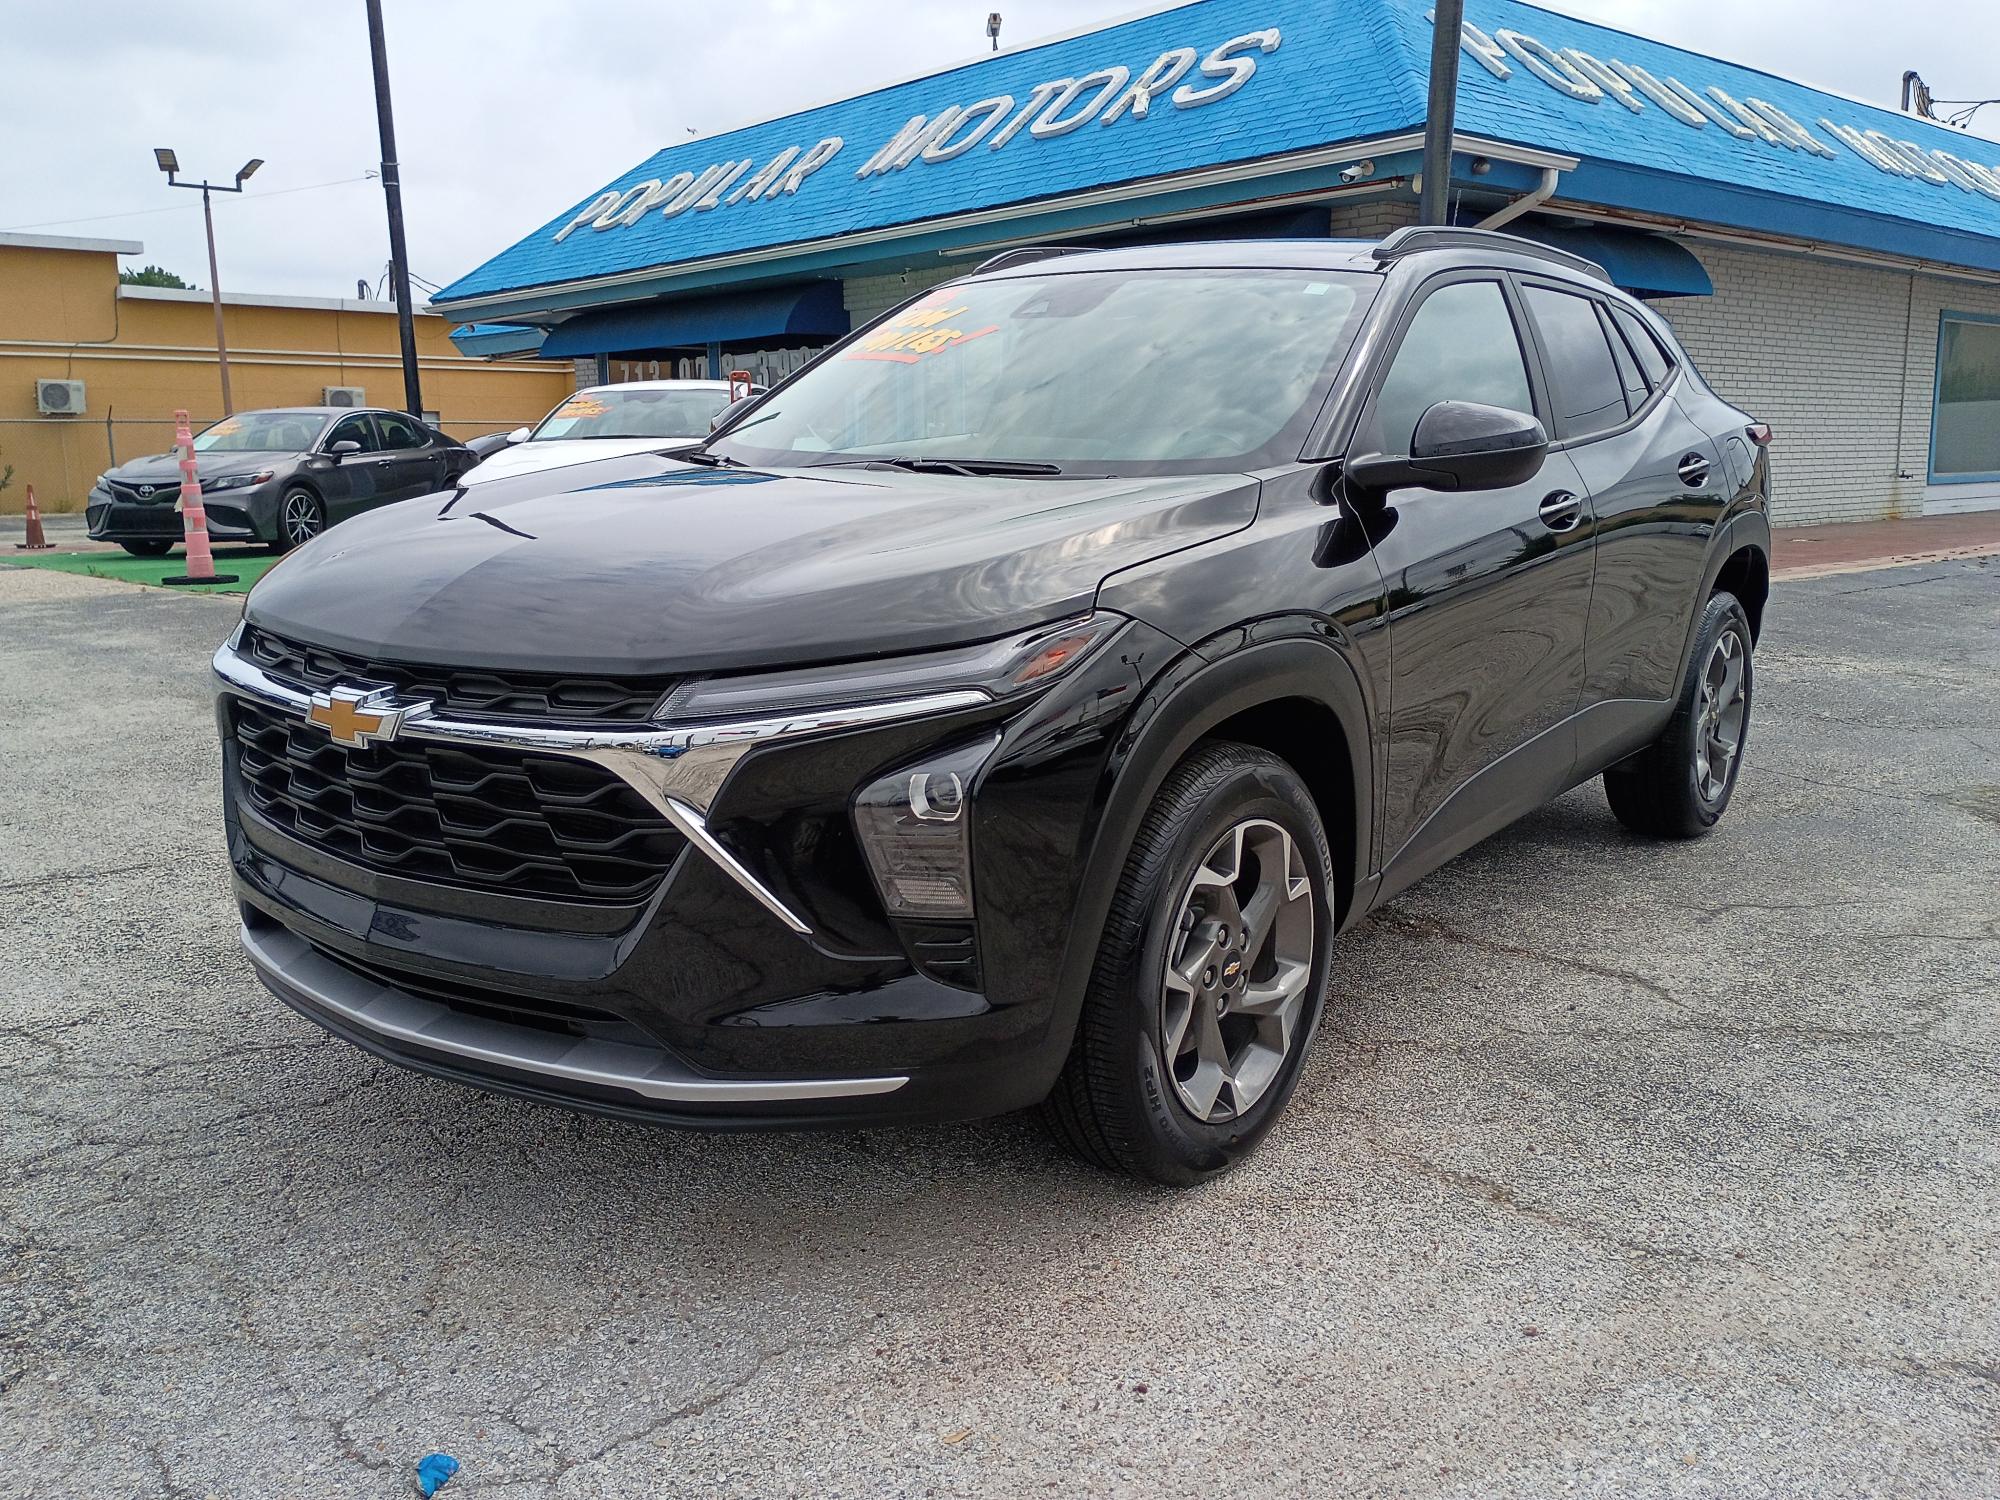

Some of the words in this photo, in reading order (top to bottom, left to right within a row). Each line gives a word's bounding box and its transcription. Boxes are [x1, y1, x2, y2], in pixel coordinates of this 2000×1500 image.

[551, 135, 844, 243] POPULAR
[855, 27, 1282, 179] MOTORS
[1424, 8, 1838, 161] POPULAR
